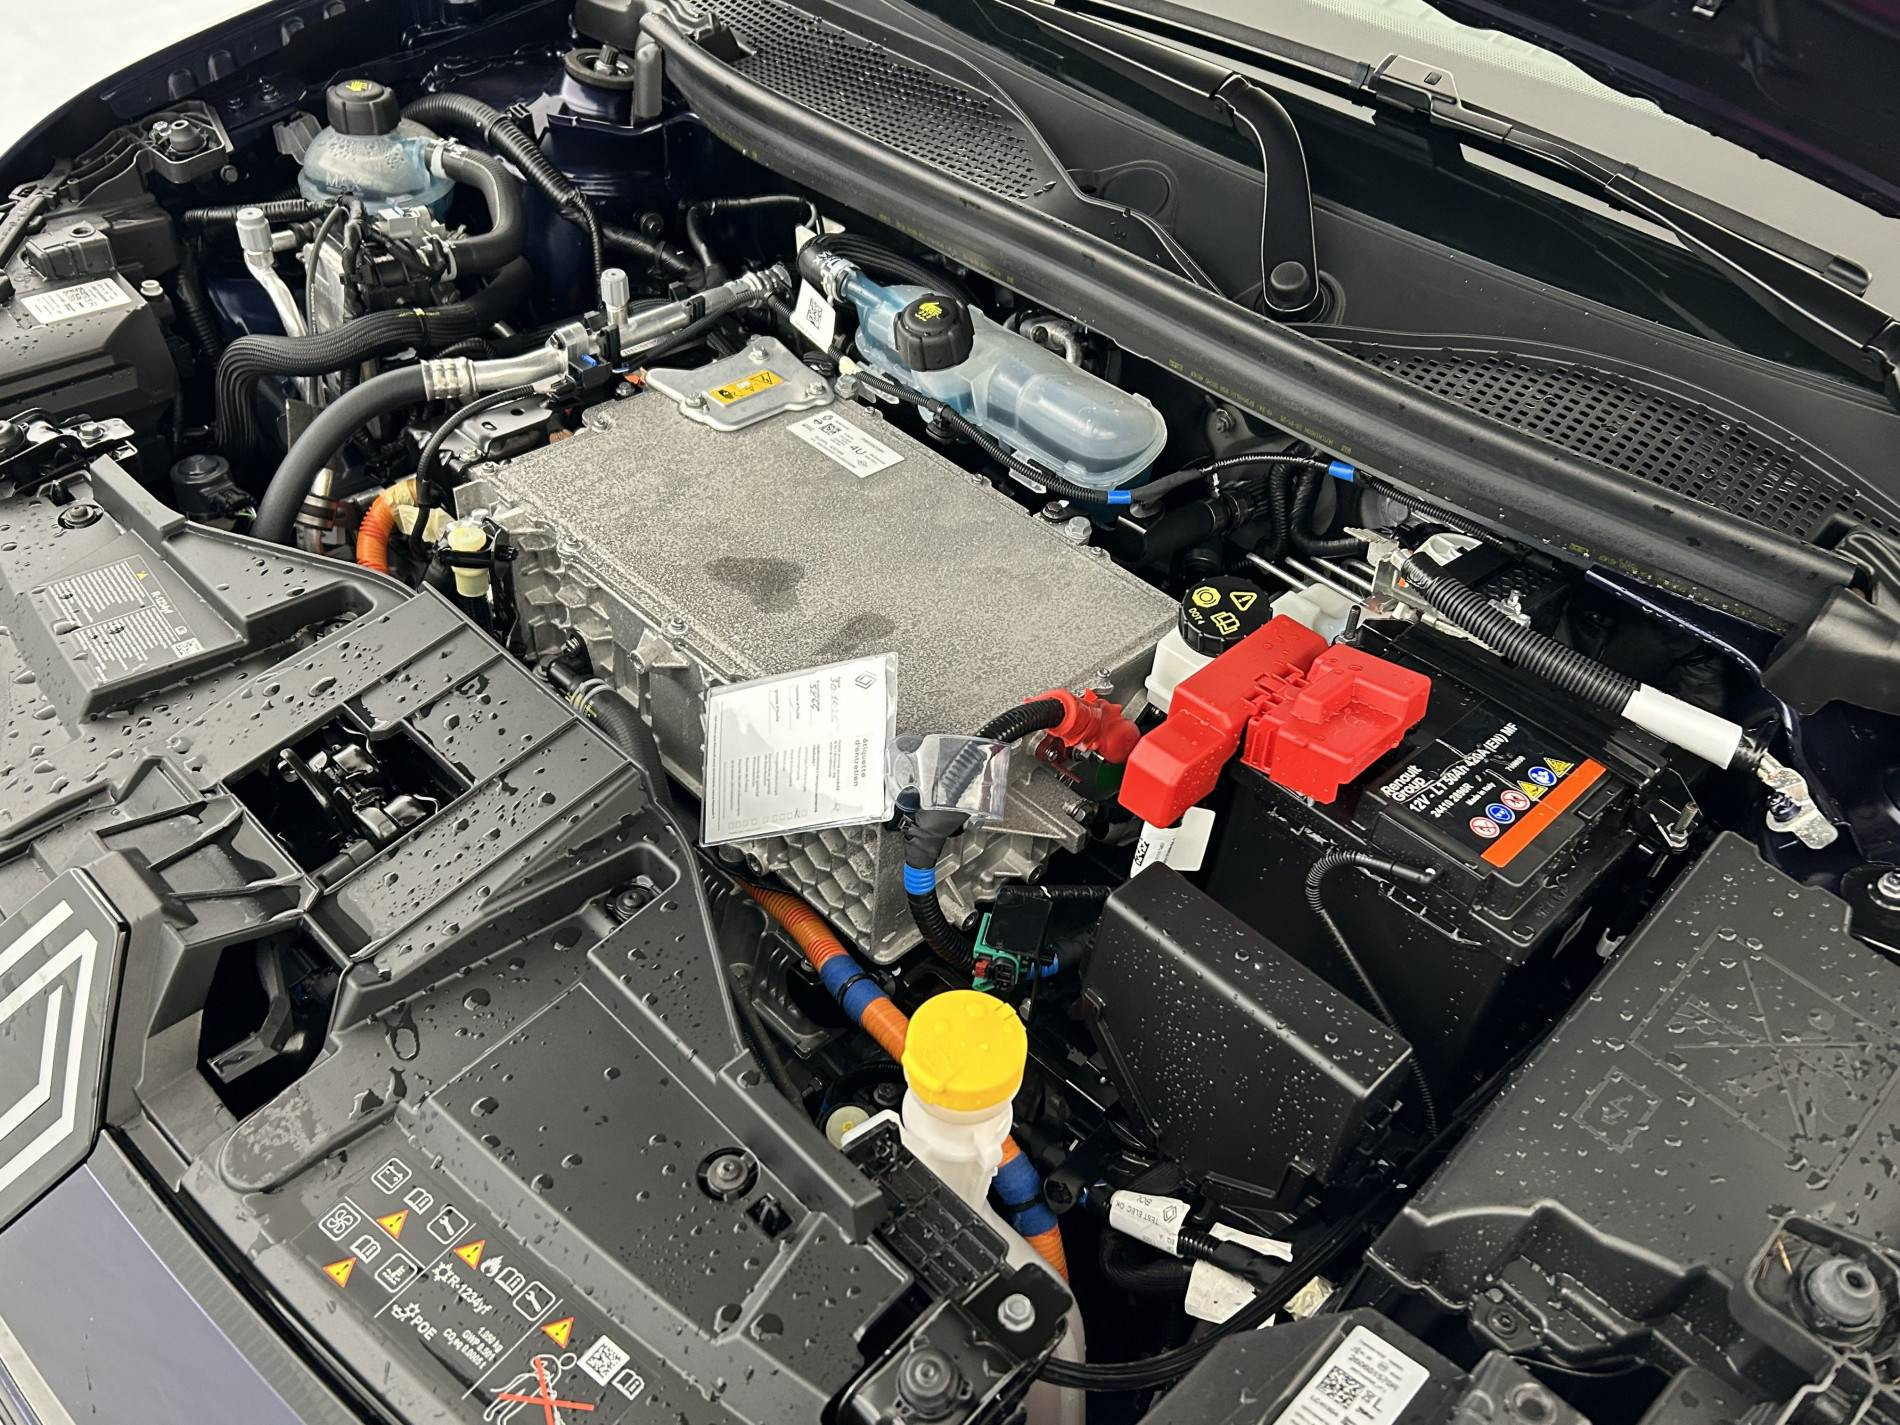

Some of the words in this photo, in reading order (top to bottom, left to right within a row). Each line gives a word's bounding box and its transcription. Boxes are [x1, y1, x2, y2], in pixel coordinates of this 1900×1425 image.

[1188, 607, 1203, 621] DOT
[1409, 794, 1431, 813] 12V
[1434, 780, 1448, 796] L1
[1444, 764, 1470, 787] 50Ah
[1464, 748, 1490, 770] 420A
[1483, 733, 1509, 755] (EN)
[1501, 722, 1518, 737] MF
[1380, 764, 1422, 797] Renault
[1392, 777, 1426, 802] Group
[1465, 795, 1480, 806] Made
[1482, 781, 1496, 796] Italy
[1430, 798, 1452, 818] 24410
[1115, 1200, 1125, 1210] OK
[1126, 1206, 1143, 1218] ELEC
[1144, 1214, 1160, 1226] TEST
[447, 1275, 493, 1315] R-1234yf
[410, 1315, 438, 1341] POE
[462, 1330, 481, 1346] GWP
[492, 1340, 504, 1354] kg
